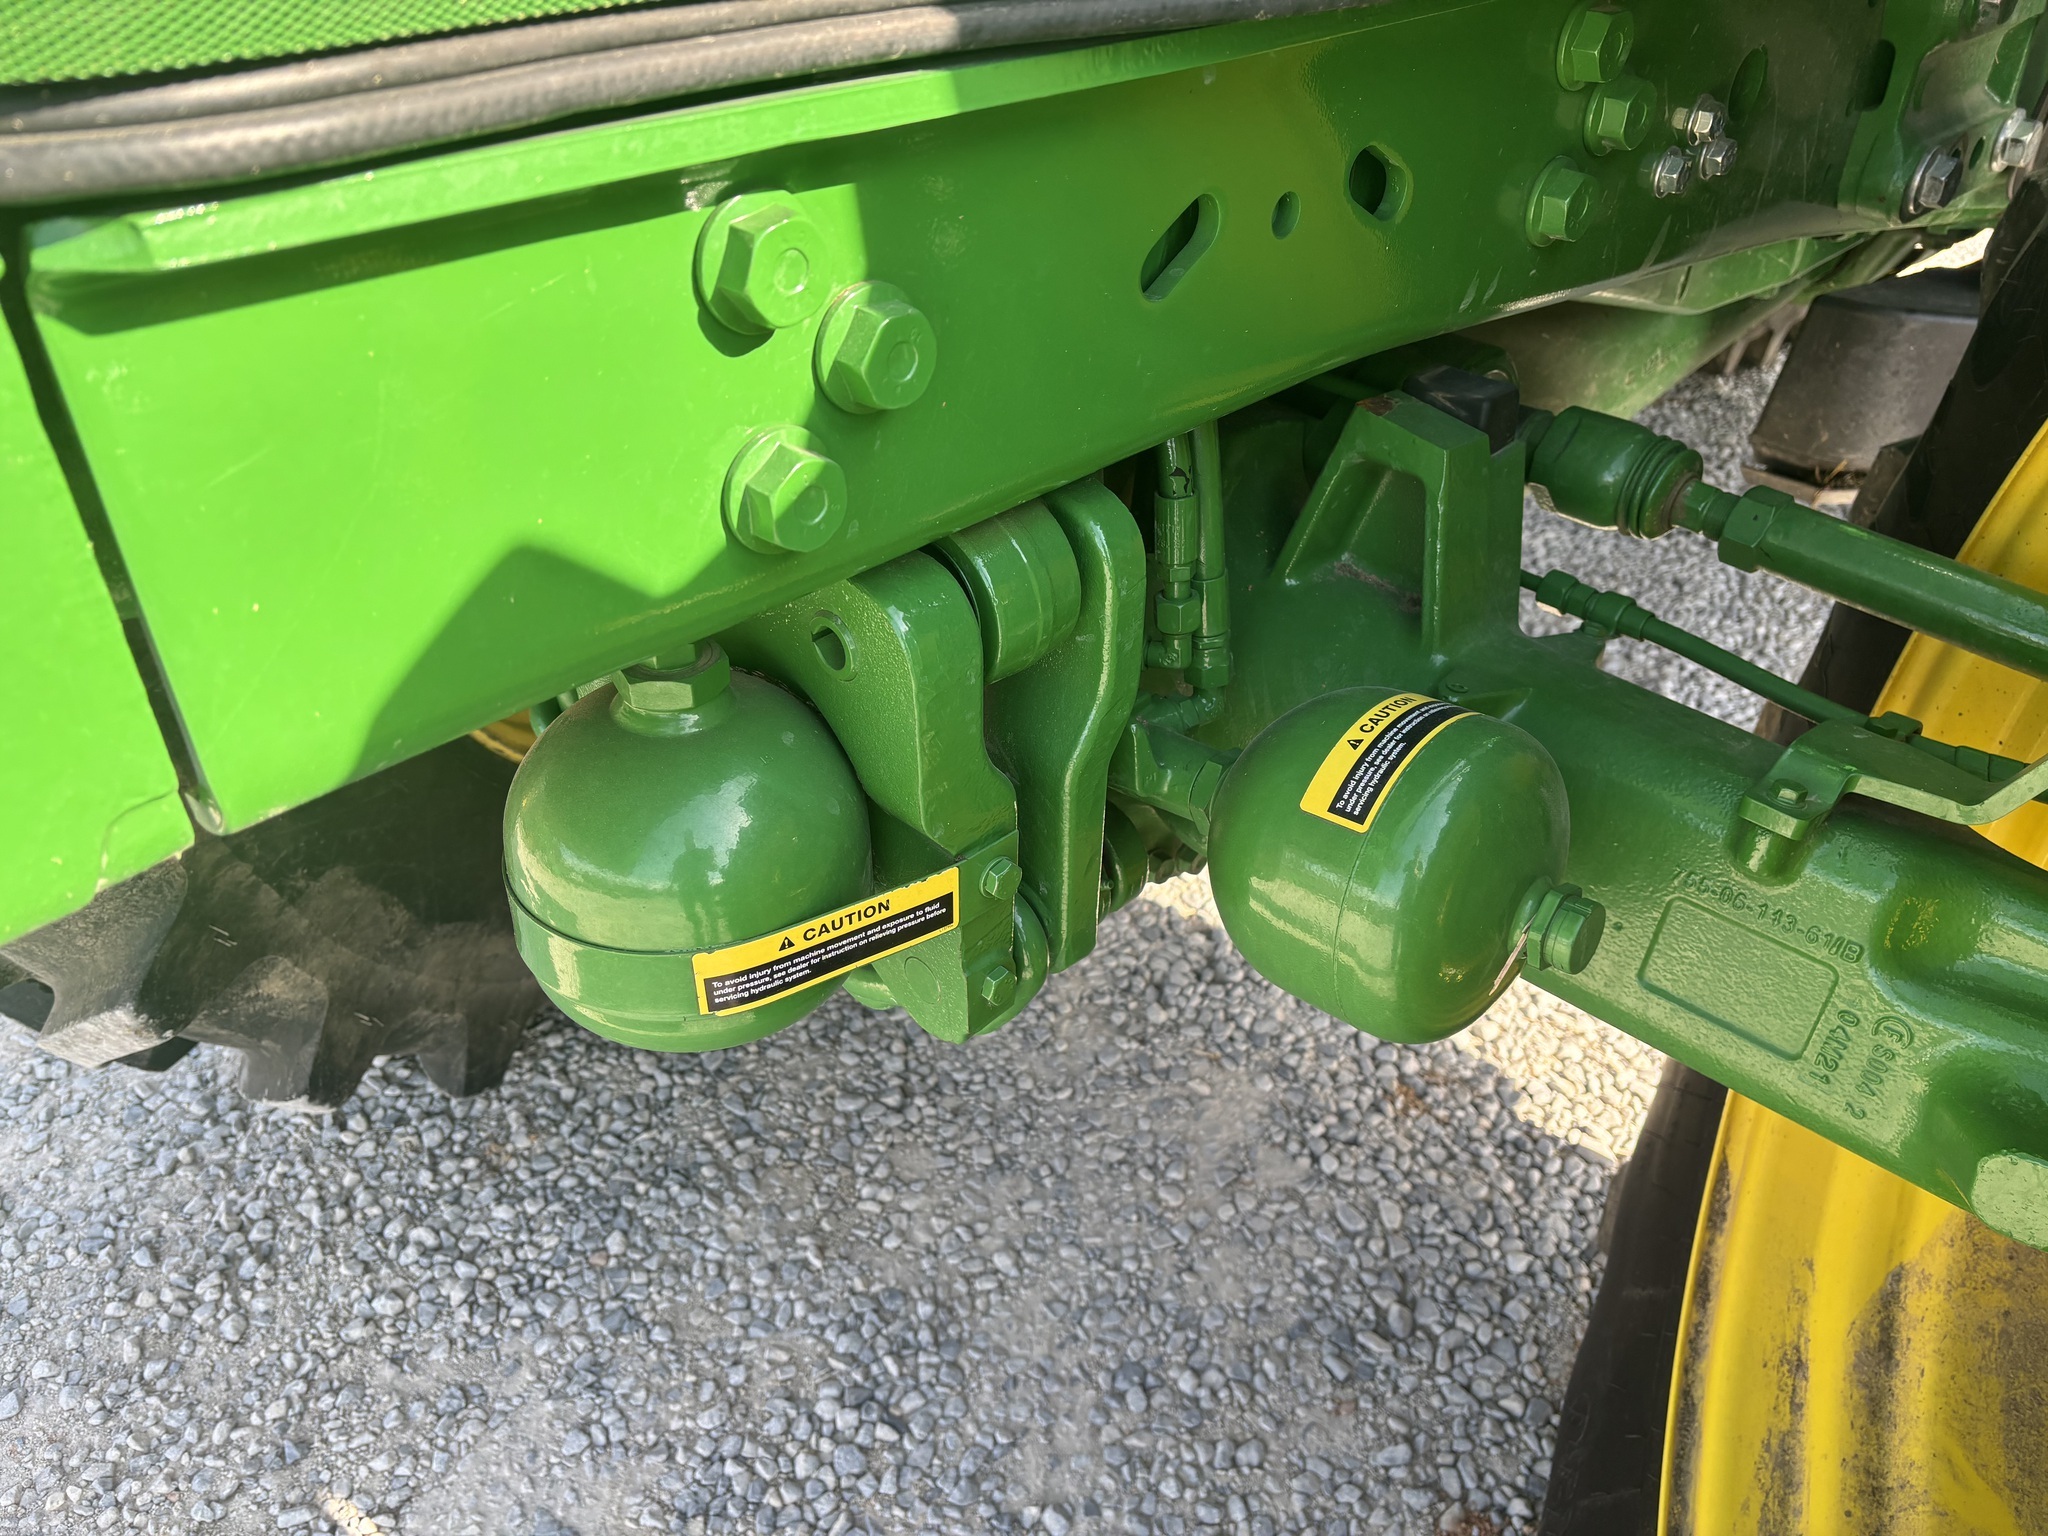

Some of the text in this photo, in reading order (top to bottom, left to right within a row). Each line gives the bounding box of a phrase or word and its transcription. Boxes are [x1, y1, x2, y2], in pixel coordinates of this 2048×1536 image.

[1360, 696, 1417, 733] CAUTION
[1336, 800, 1345, 809] To
[1342, 780, 1356, 799] avoid
[1353, 762, 1369, 780] injury
[1365, 748, 1379, 762] from
[1377, 728, 1398, 748] machine
[1345, 793, 1358, 812] under
[1356, 766, 1377, 793] pressure,
[1374, 755, 1384, 765] see
[1382, 740, 1396, 755] dealer
[1394, 733, 1403, 741] for
[1353, 742, 1406, 815] servicing hydraulic system.
[713, 986, 736, 996] under
[738, 977, 772, 991] pressure,
[773, 971, 786, 979] see
[787, 961, 809, 973] dealer
[811, 957, 821, 965] for
[822, 942, 858, 960] instruction
[869, 926, 896, 942] relieving
[897, 917, 925, 932] pressure
[926, 907, 947, 920] before
[725, 974, 747, 986] avoid
[749, 968, 771, 980] injury
[773, 961, 791, 971] from
[793, 948, 825, 964] machine
[827, 932, 865, 951] movement
[867, 926, 881, 936] and
[882, 913, 914, 930] exposure
[925, 902, 940, 913] fluid
[803, 899, 890, 942] CAUTION
[715, 969, 812, 1003] servicing hydraulic system.
